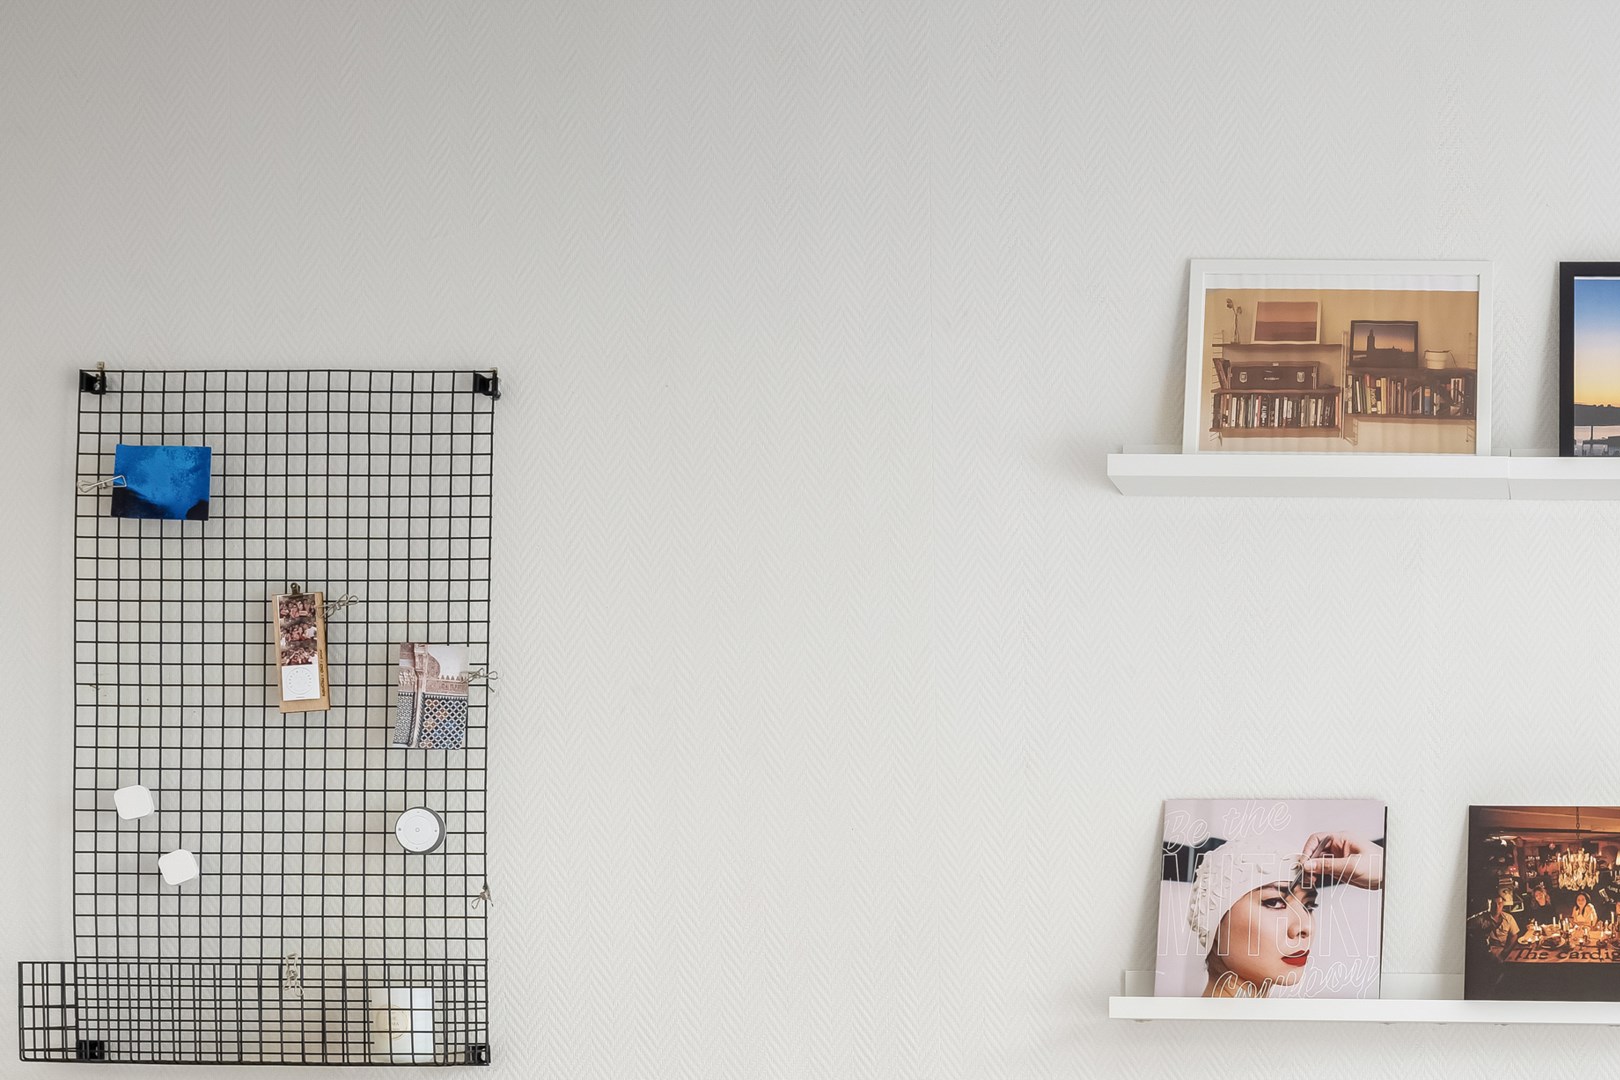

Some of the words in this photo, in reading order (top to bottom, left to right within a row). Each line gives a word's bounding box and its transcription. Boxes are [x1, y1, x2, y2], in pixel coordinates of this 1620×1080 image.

[1162, 810, 1211, 855] Be
[1222, 799, 1292, 841] the
[1157, 853, 1382, 958] MITSKI
[1211, 956, 1380, 999] Cowboy
